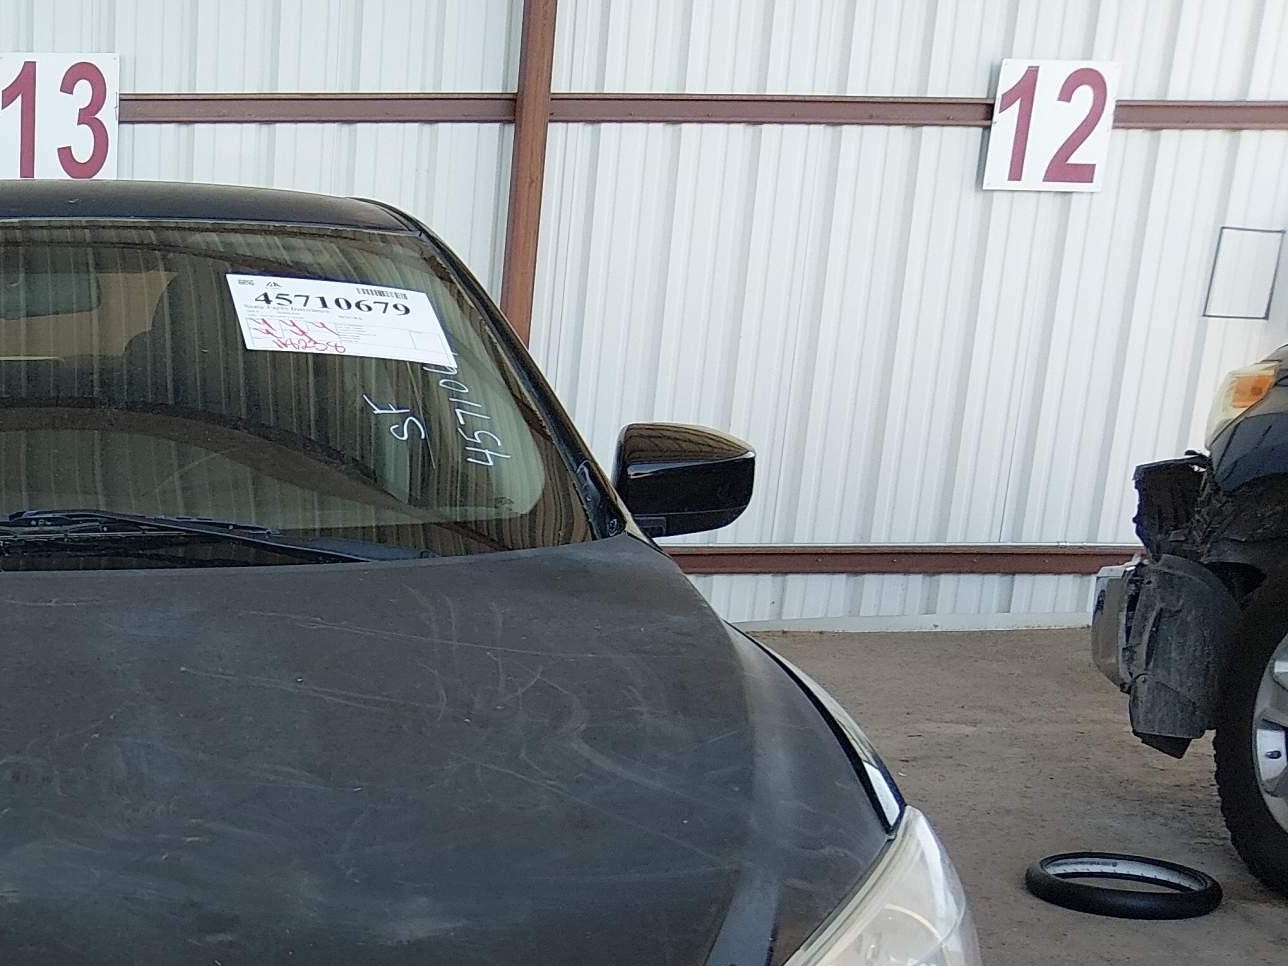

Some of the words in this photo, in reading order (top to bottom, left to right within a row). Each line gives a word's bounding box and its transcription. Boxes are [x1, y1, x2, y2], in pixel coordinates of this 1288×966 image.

[1, 60, 110, 180] 13
[998, 65, 1108, 184] 12
[254, 291, 411, 316] 45710679
